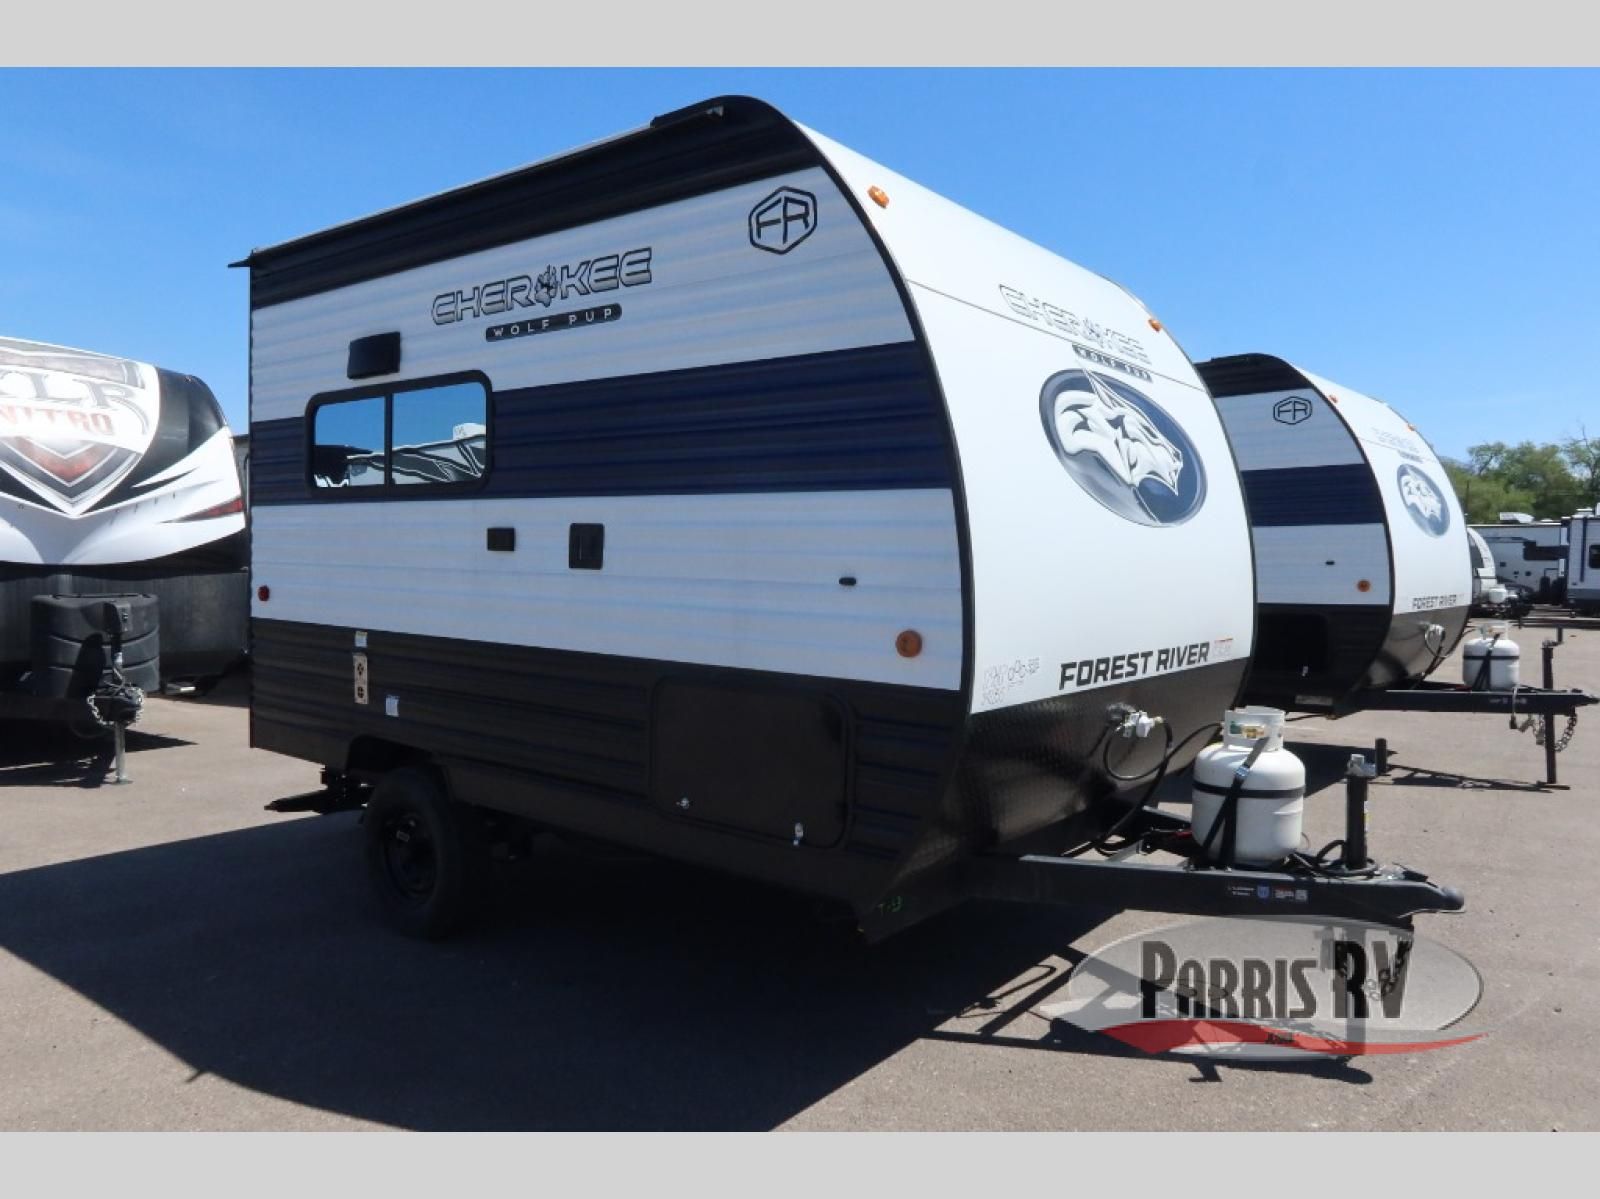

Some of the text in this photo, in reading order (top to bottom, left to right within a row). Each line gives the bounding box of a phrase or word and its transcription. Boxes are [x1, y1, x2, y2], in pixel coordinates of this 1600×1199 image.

[431, 246, 653, 326] CHEROKEE
[493, 308, 613, 338] WOLF PUP
[1059, 651, 1153, 690] FOREST
[1155, 641, 1210, 672] RIVER
